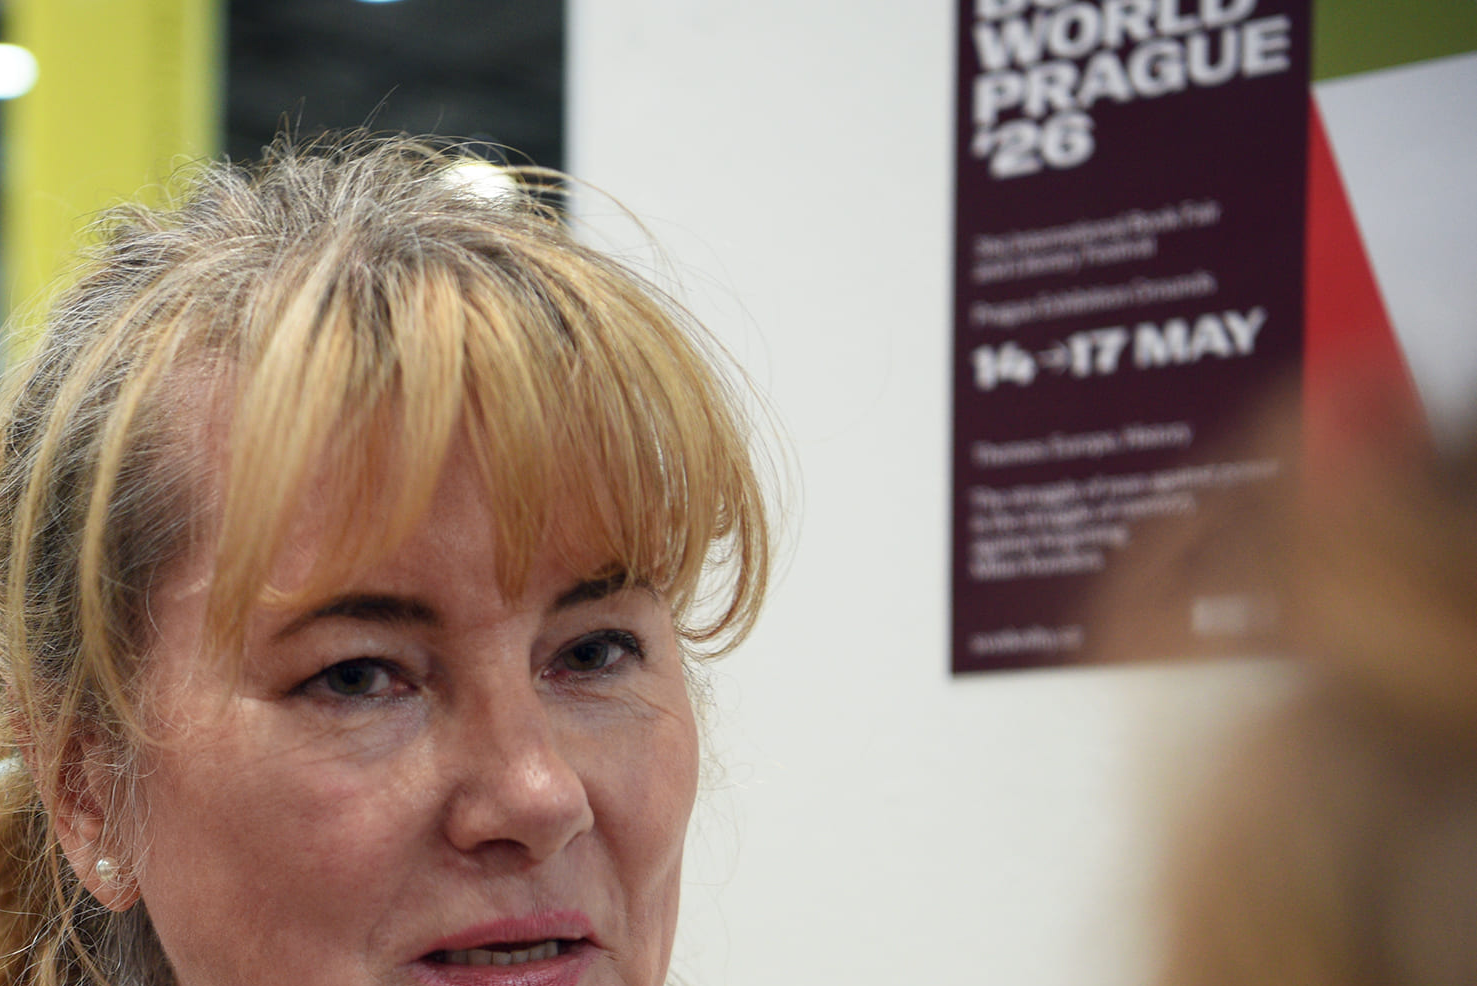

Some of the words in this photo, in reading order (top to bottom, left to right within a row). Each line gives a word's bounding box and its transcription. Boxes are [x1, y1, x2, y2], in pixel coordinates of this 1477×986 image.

[974, 14, 1292, 126] PRAGUE
[975, 0, 1258, 71] WORLD
[1132, 305, 1269, 369] MAY
